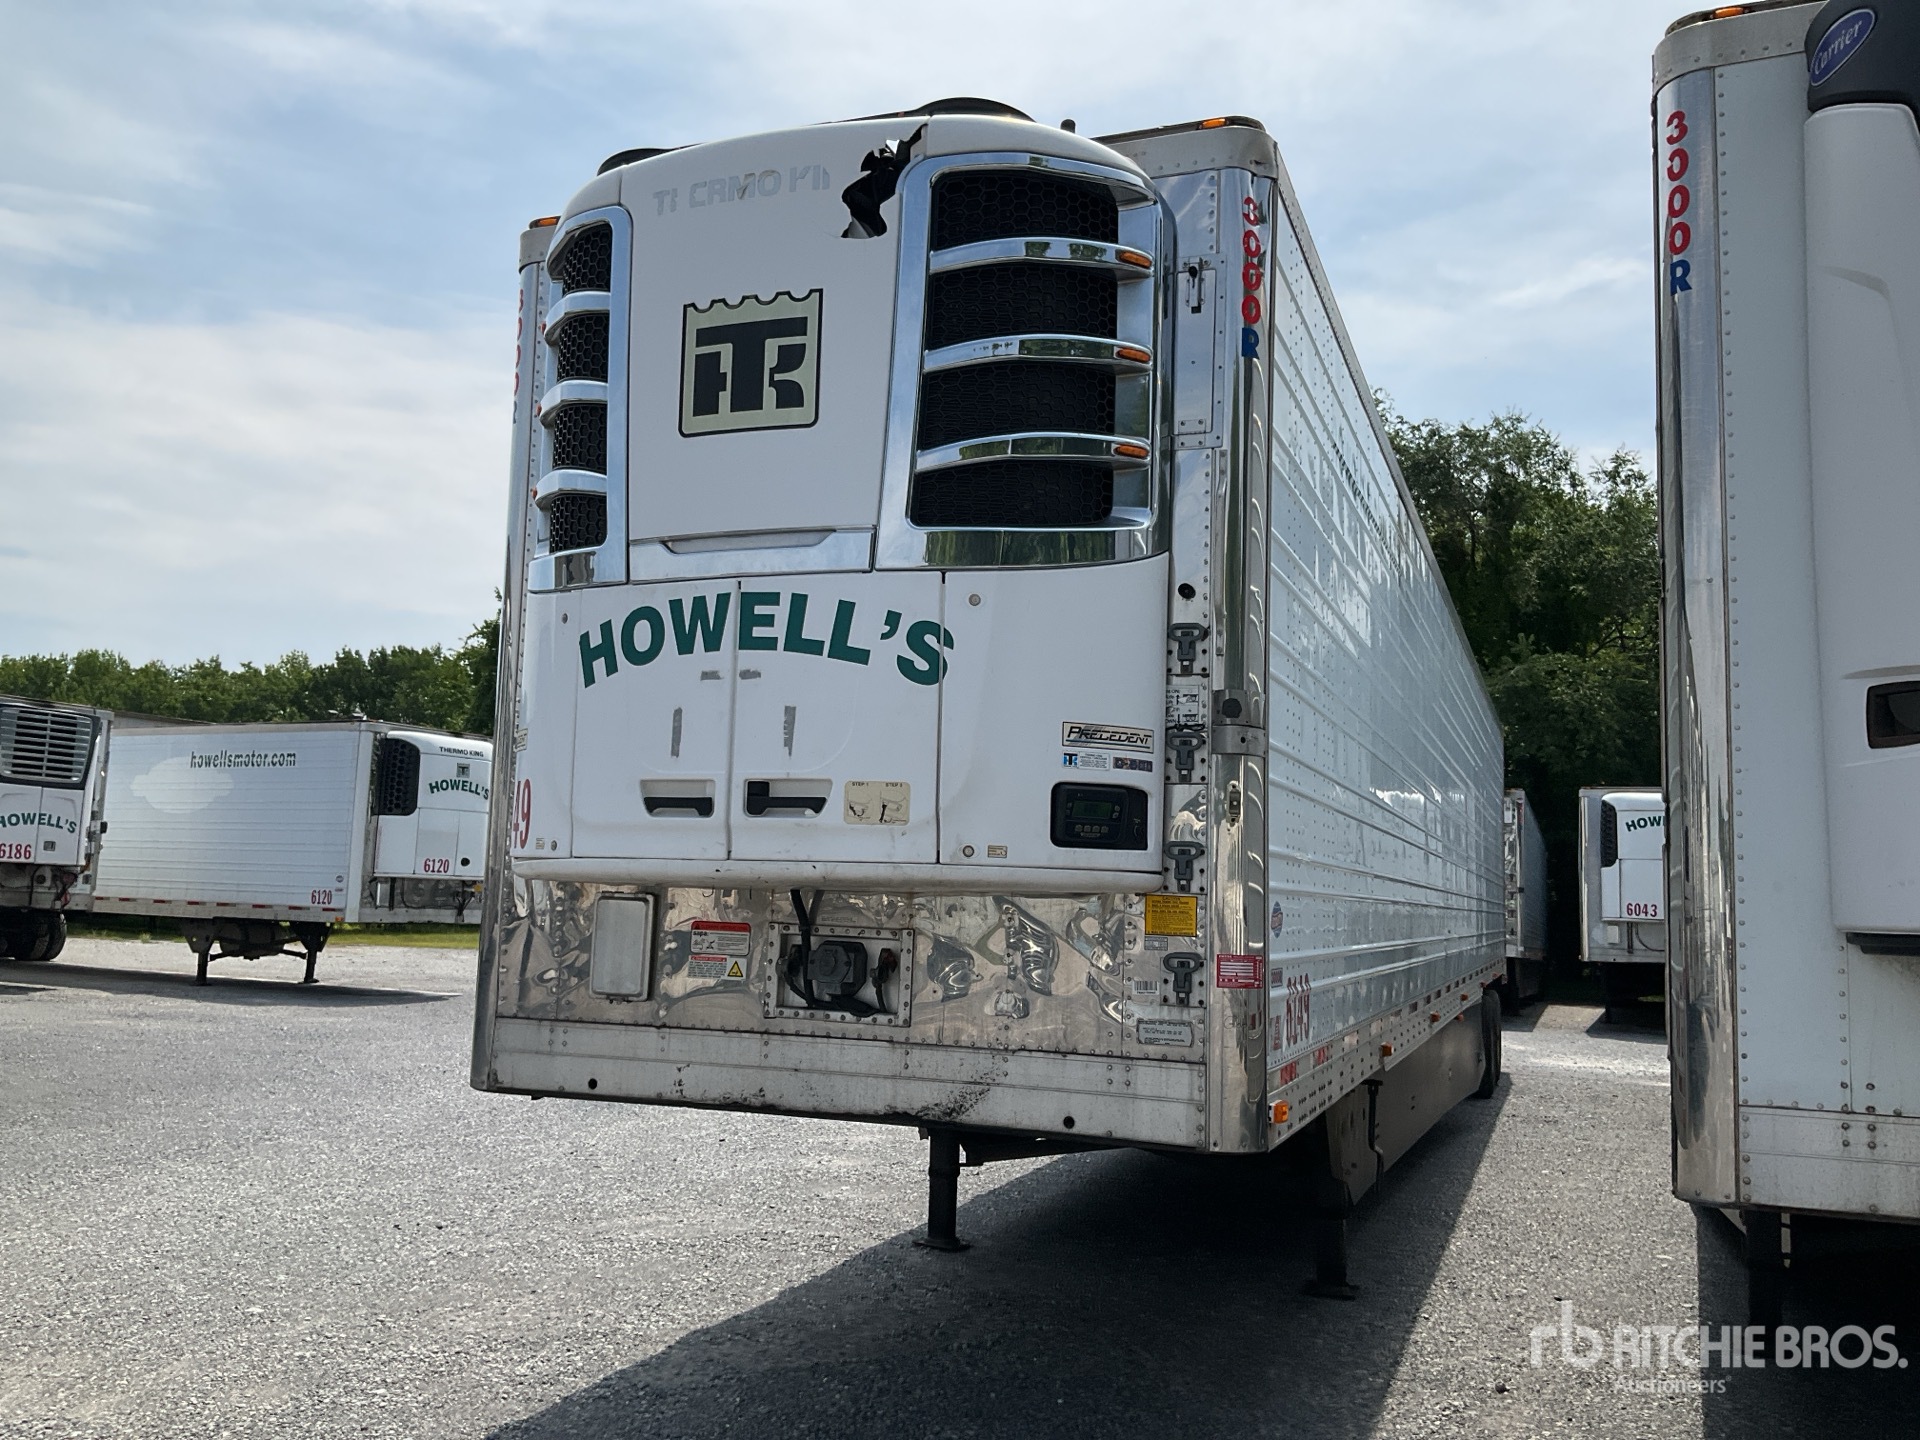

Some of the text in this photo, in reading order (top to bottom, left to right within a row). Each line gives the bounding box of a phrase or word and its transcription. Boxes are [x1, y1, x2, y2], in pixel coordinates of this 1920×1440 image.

[1814, 19, 1865, 75] Carrier
[1666, 110, 1692, 296] 3000R
[1241, 196, 1262, 359] 3000R
[579, 592, 954, 688] HOWELL'S
[190, 750, 297, 768] howellsmotor.com
[439, 746, 484, 758] THERMO KING
[429, 778, 490, 800] HOWELL'S
[1625, 815, 1665, 832] HOW
[424, 858, 450, 873] 6120
[311, 889, 333, 905] 6120
[1626, 903, 1658, 917] 6043
